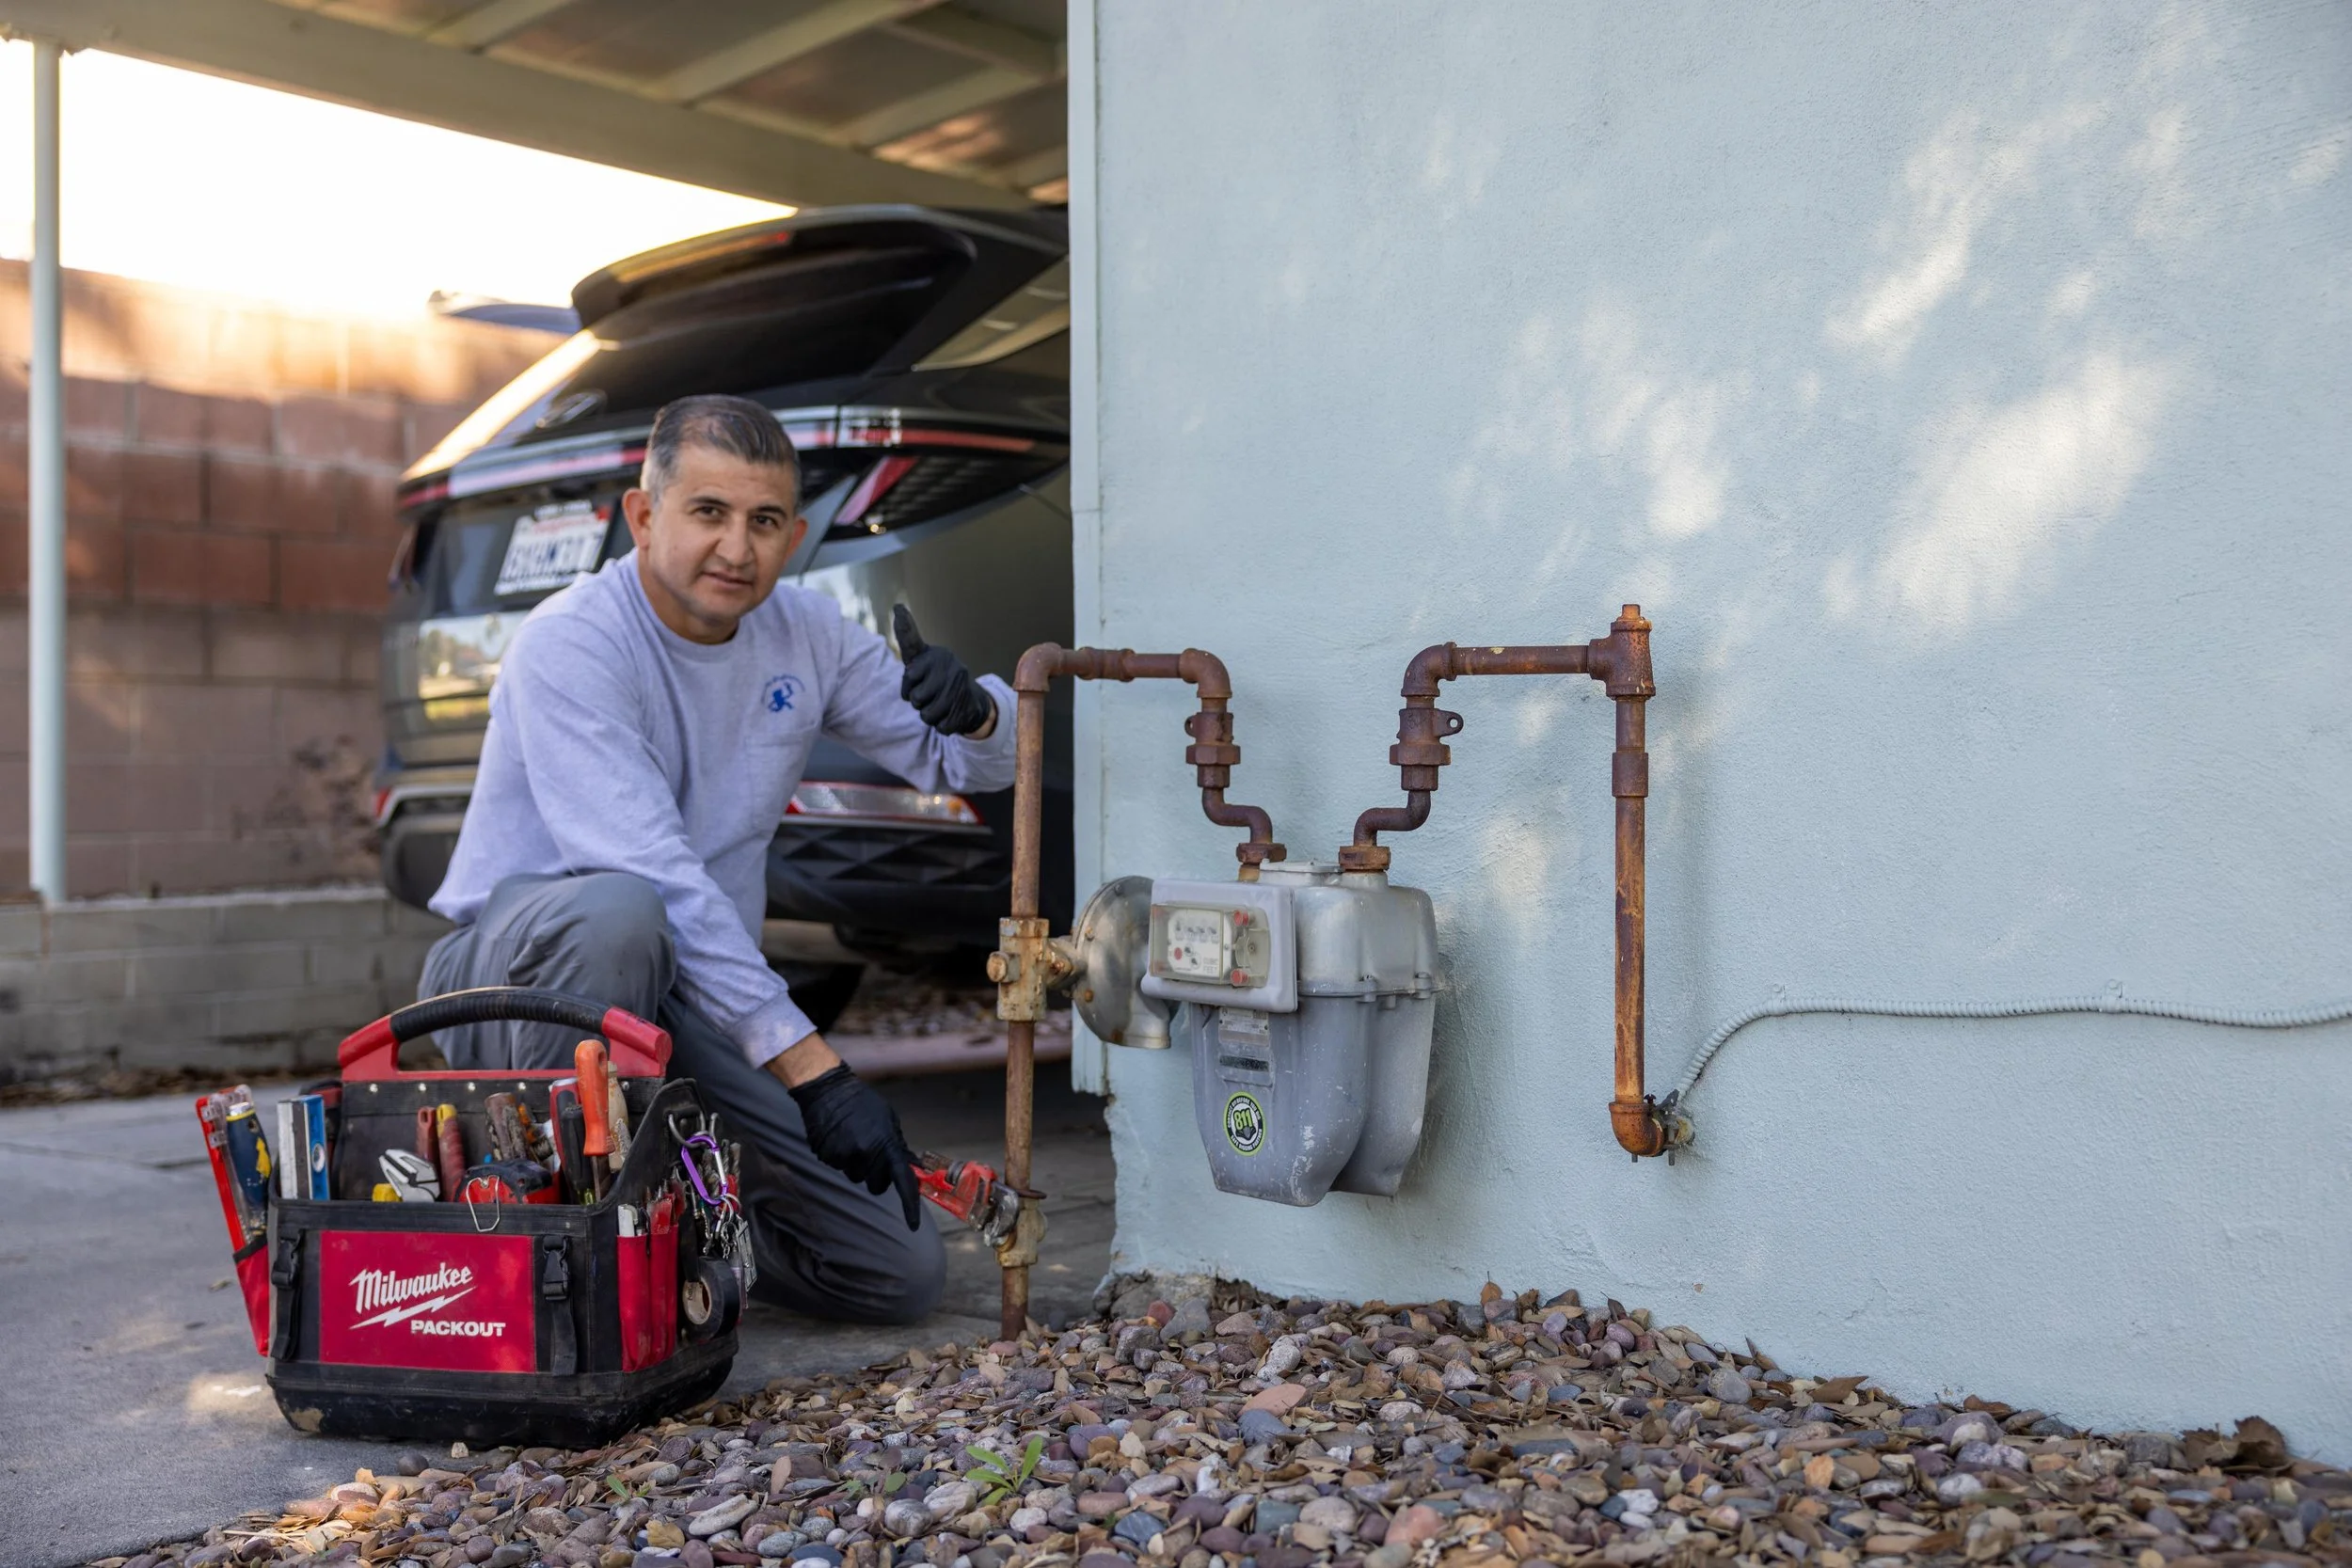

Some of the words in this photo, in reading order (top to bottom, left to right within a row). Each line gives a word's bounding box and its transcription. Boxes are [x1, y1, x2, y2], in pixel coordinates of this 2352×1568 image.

[1234, 1109, 1252, 1131] 811
[348, 1262, 473, 1314] Milwaukee
[411, 1320, 506, 1337] PACKOUT
